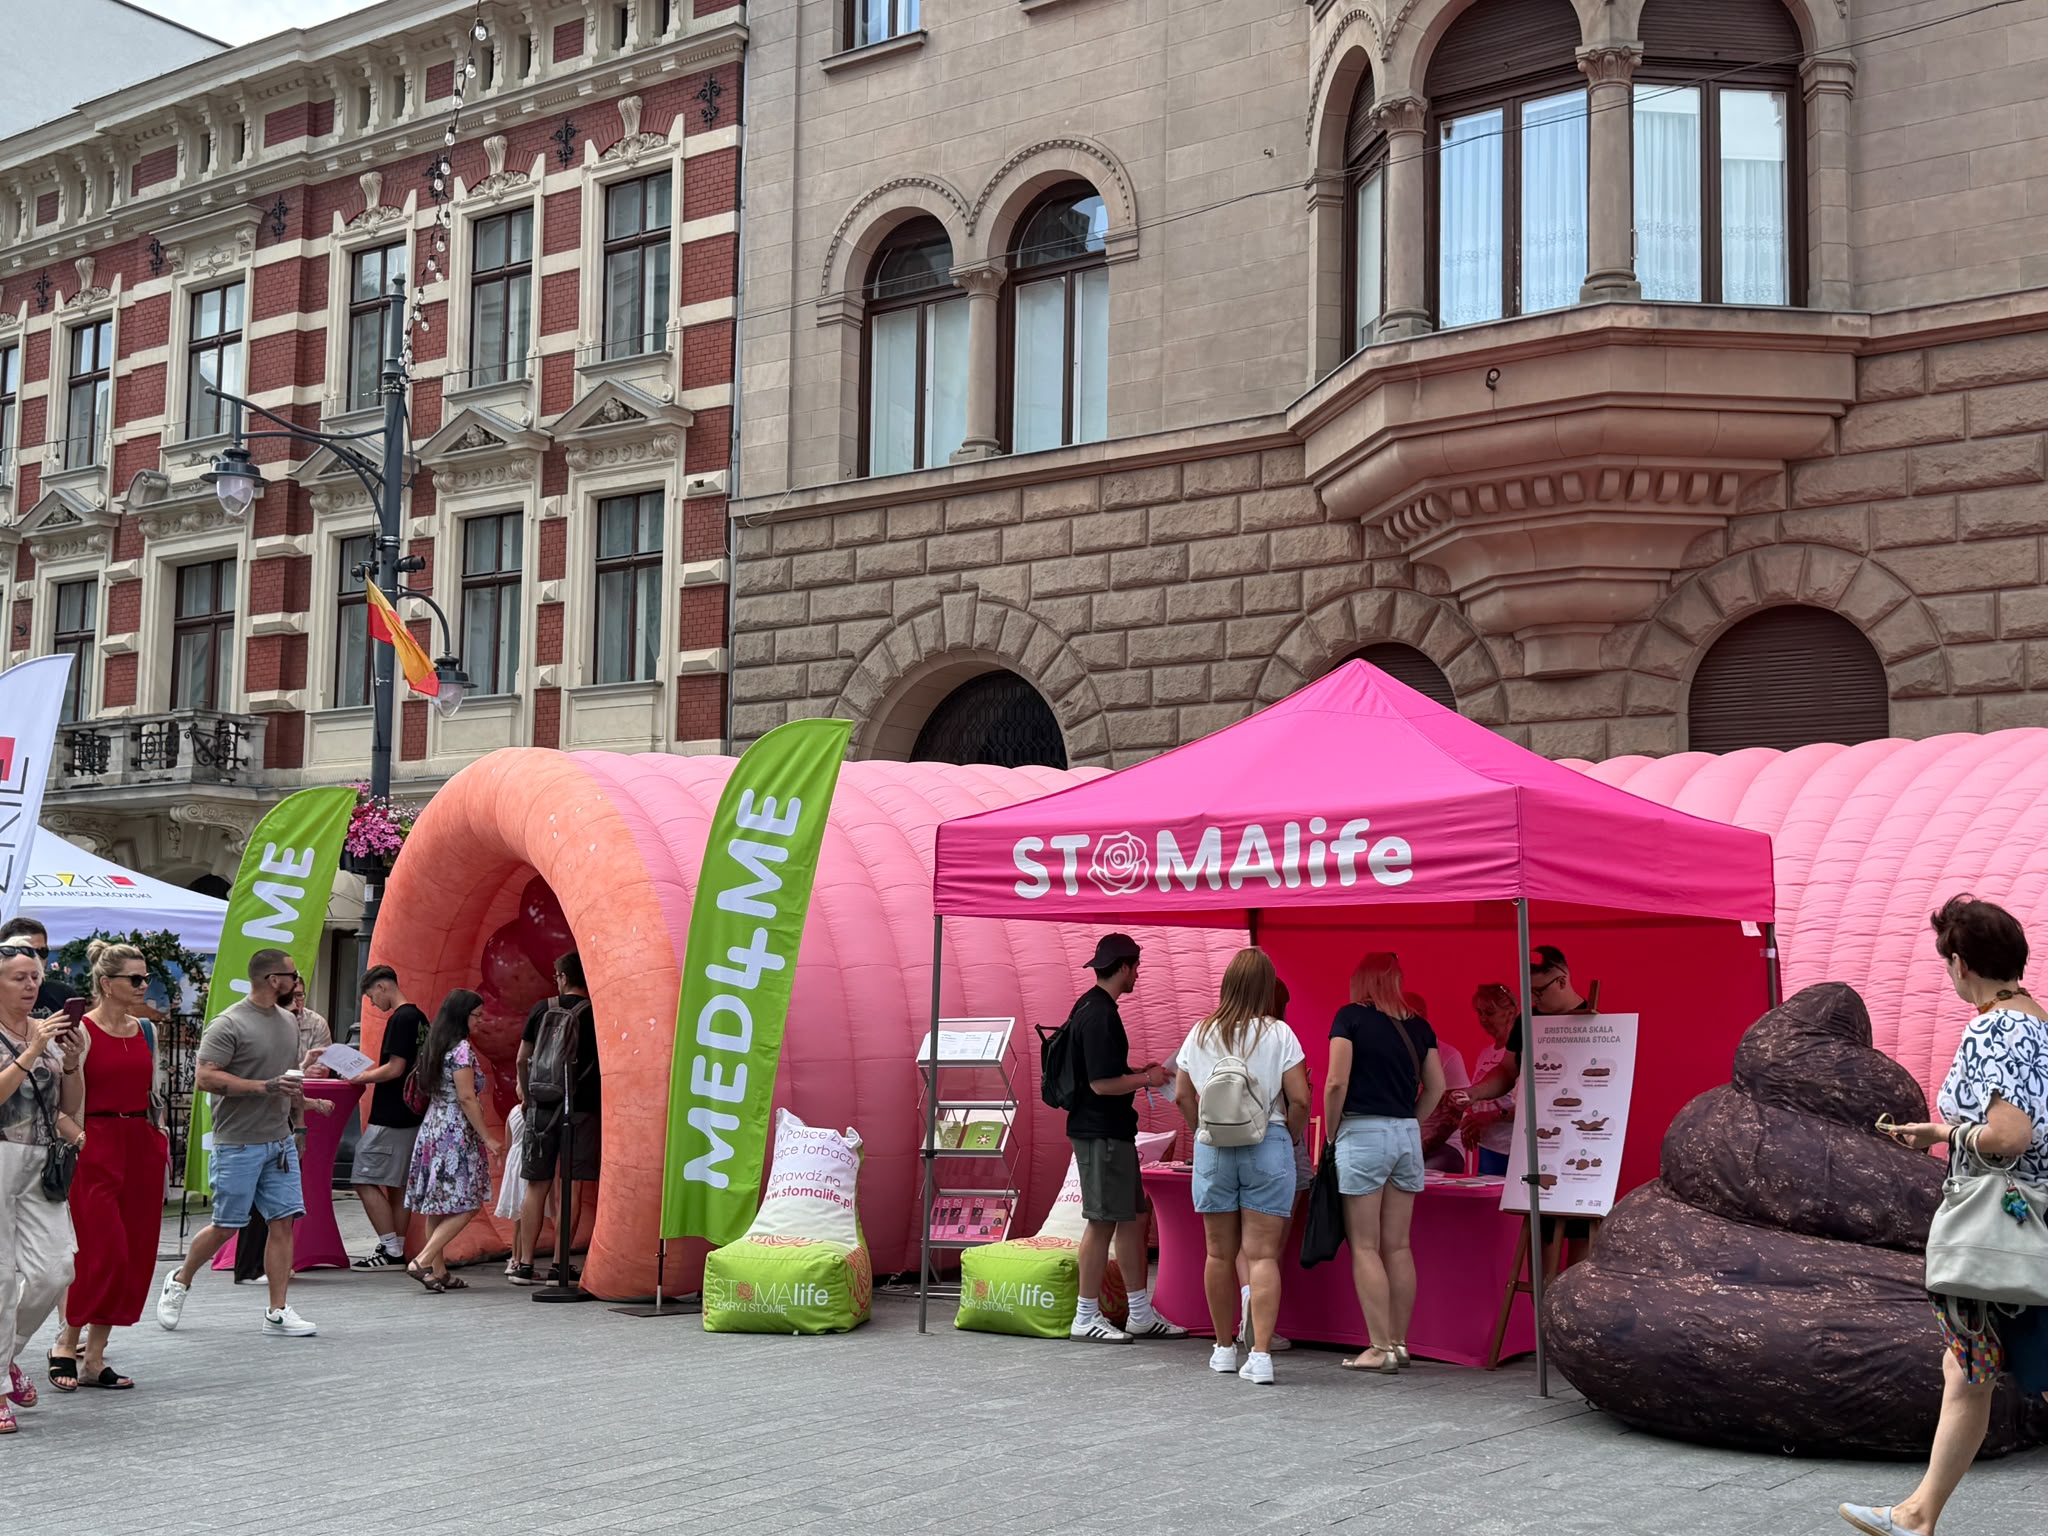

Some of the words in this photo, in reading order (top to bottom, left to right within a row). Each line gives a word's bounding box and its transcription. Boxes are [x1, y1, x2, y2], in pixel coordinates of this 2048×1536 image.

[683, 788, 802, 1190] MED4ME
[1544, 1026, 1587, 1034] BRISTOLSKA
[1589, 1026, 1613, 1034] SKALA
[1537, 1036, 1591, 1044] UFORMOWANIA
[1592, 1036, 1621, 1044] STOLCA
[786, 1128, 828, 1141] Polsce
[803, 1144, 858, 1170] torbaczy.
[824, 1175, 841, 1188] na
[764, 1185, 853, 1209] ww.stomalife.pl
[750, 1303, 788, 1316] STOMIĘ
